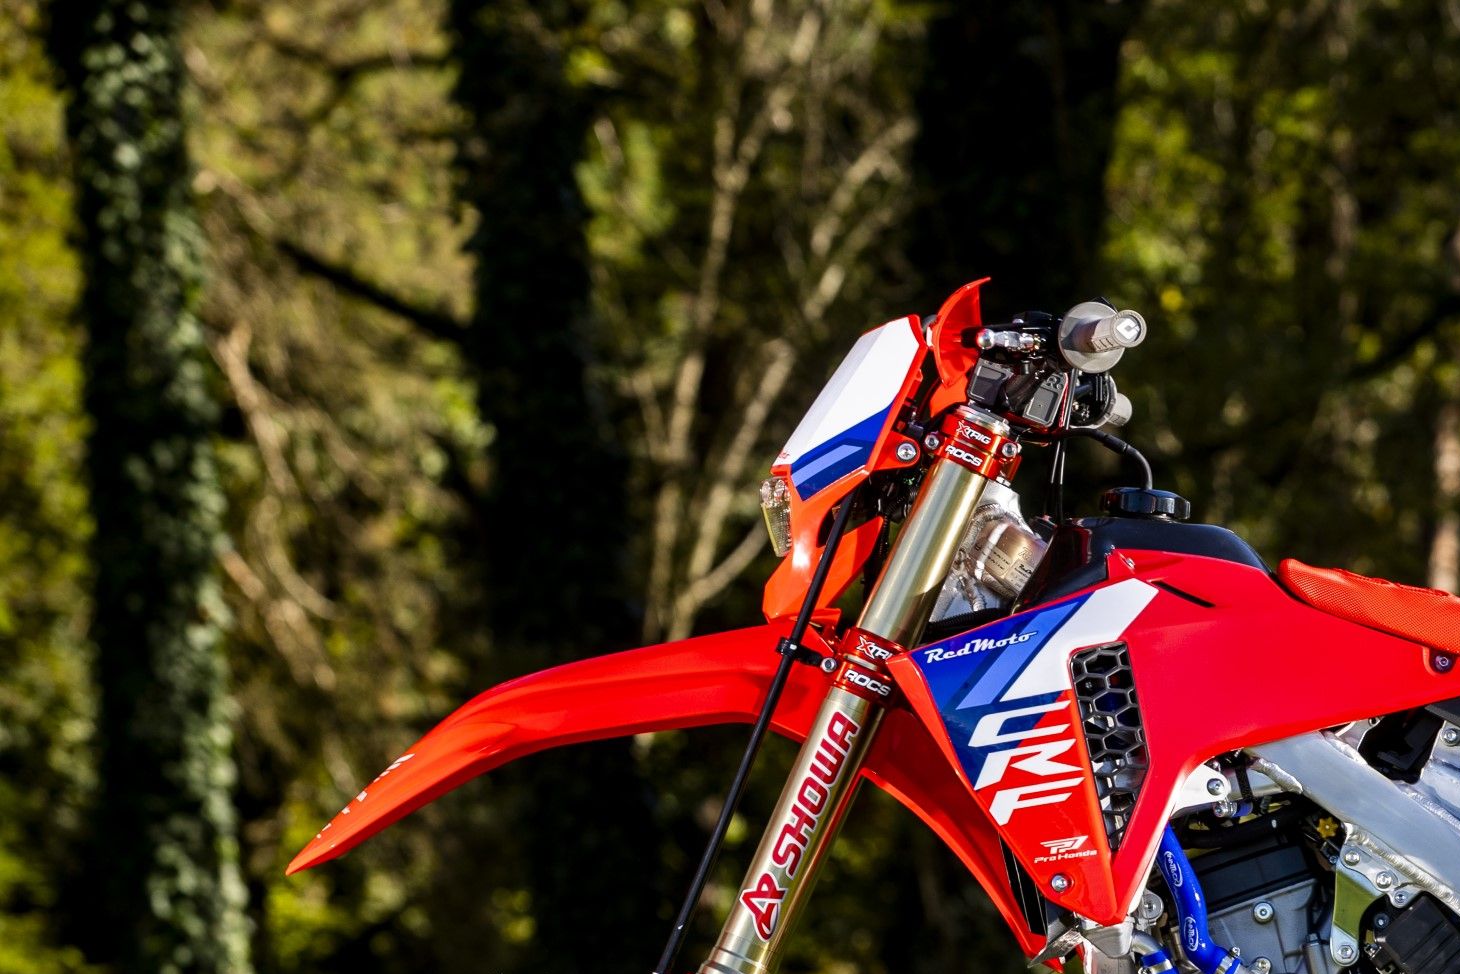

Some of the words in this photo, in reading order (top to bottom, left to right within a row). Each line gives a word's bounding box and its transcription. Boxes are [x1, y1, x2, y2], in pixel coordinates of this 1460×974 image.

[945, 445, 983, 467] ROCS
[856, 635, 894, 660] XTRI
[924, 631, 1038, 664] RedMoto
[844, 669, 892, 697] ROCS
[968, 700, 1086, 827] CRF
[771, 711, 861, 880] SHOWA
[1033, 855, 1057, 864] Pro
[1057, 849, 1098, 861] Honda
